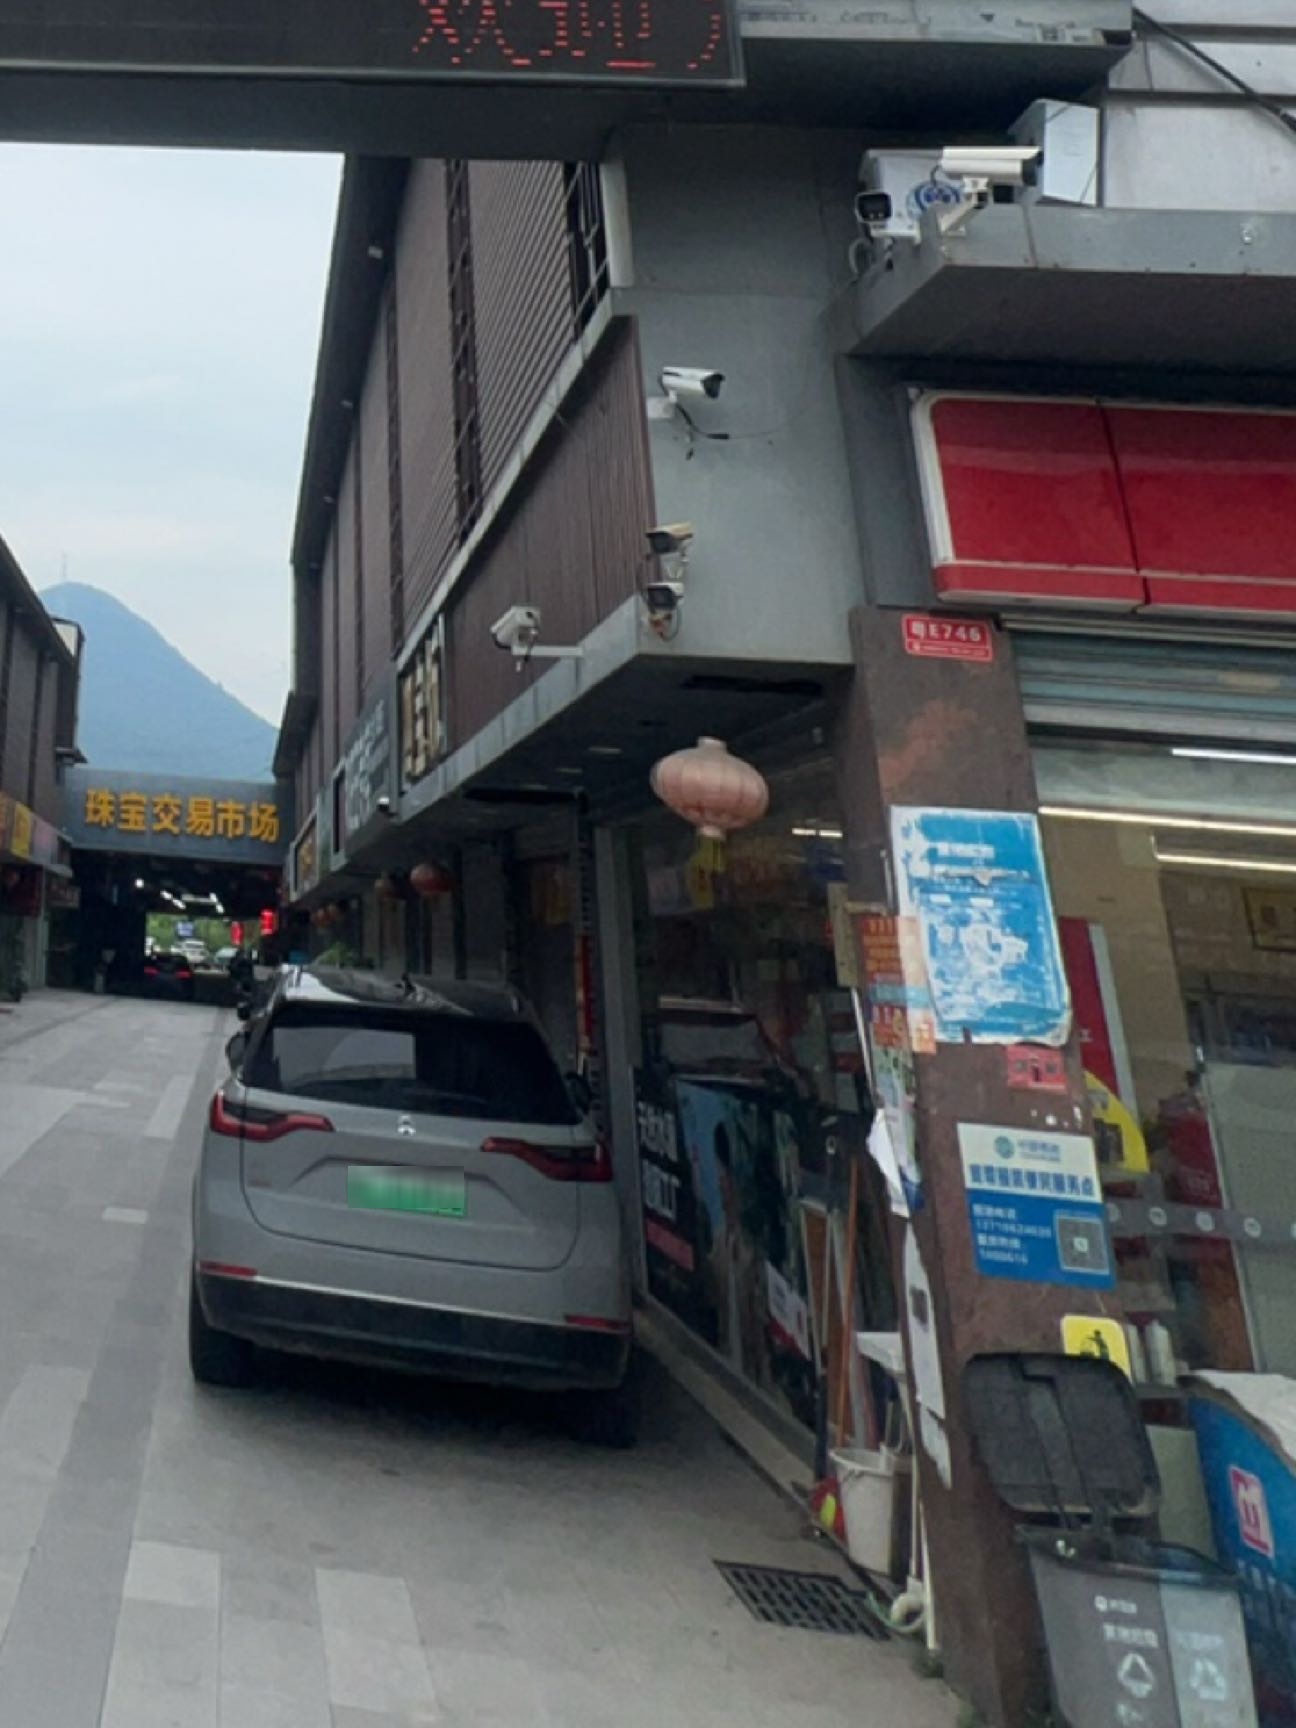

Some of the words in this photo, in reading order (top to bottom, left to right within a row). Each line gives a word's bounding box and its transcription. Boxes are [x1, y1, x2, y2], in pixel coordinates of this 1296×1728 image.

[85, 788, 281, 843] 珠宝交易市场
